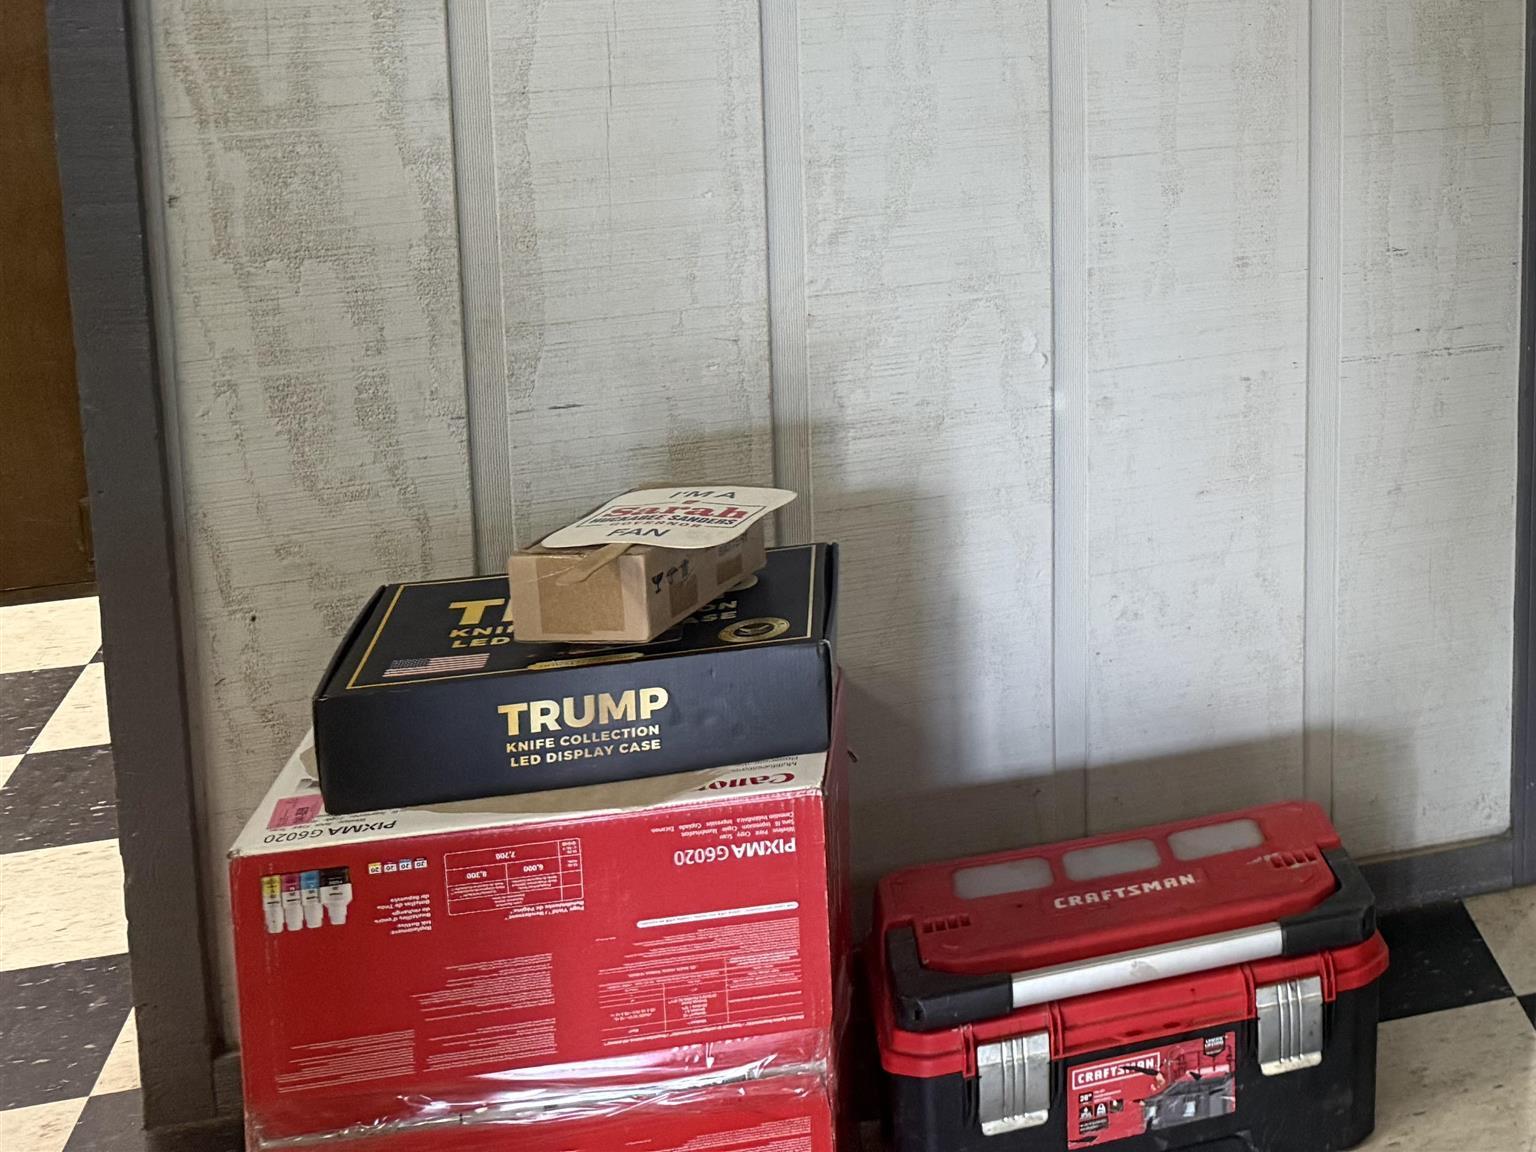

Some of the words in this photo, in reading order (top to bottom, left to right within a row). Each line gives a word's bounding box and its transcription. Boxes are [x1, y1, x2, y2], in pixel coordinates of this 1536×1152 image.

[669, 490, 714, 499] I'M
[713, 491, 737, 499] A
[588, 514, 666, 525] HUCKABEE
[670, 514, 738, 526] SANDERS
[606, 528, 671, 537] FAN
[451, 636, 511, 649] LED
[497, 687, 669, 736] TRUMP
[506, 738, 555, 753] KNIFE
[560, 724, 660, 746] COLLECTION
[510, 754, 541, 768] LED
[546, 745, 614, 763] DISPLAY
[619, 739, 661, 754] CASE
[263, 829, 324, 843] G6020
[328, 820, 396, 836] PIXMA
[673, 845, 729, 866] G6020
[731, 837, 796, 859] PIXMA
[1054, 874, 1196, 909] CRAFTSMAN
[1077, 1057, 1155, 1085] CRAFTSAN
